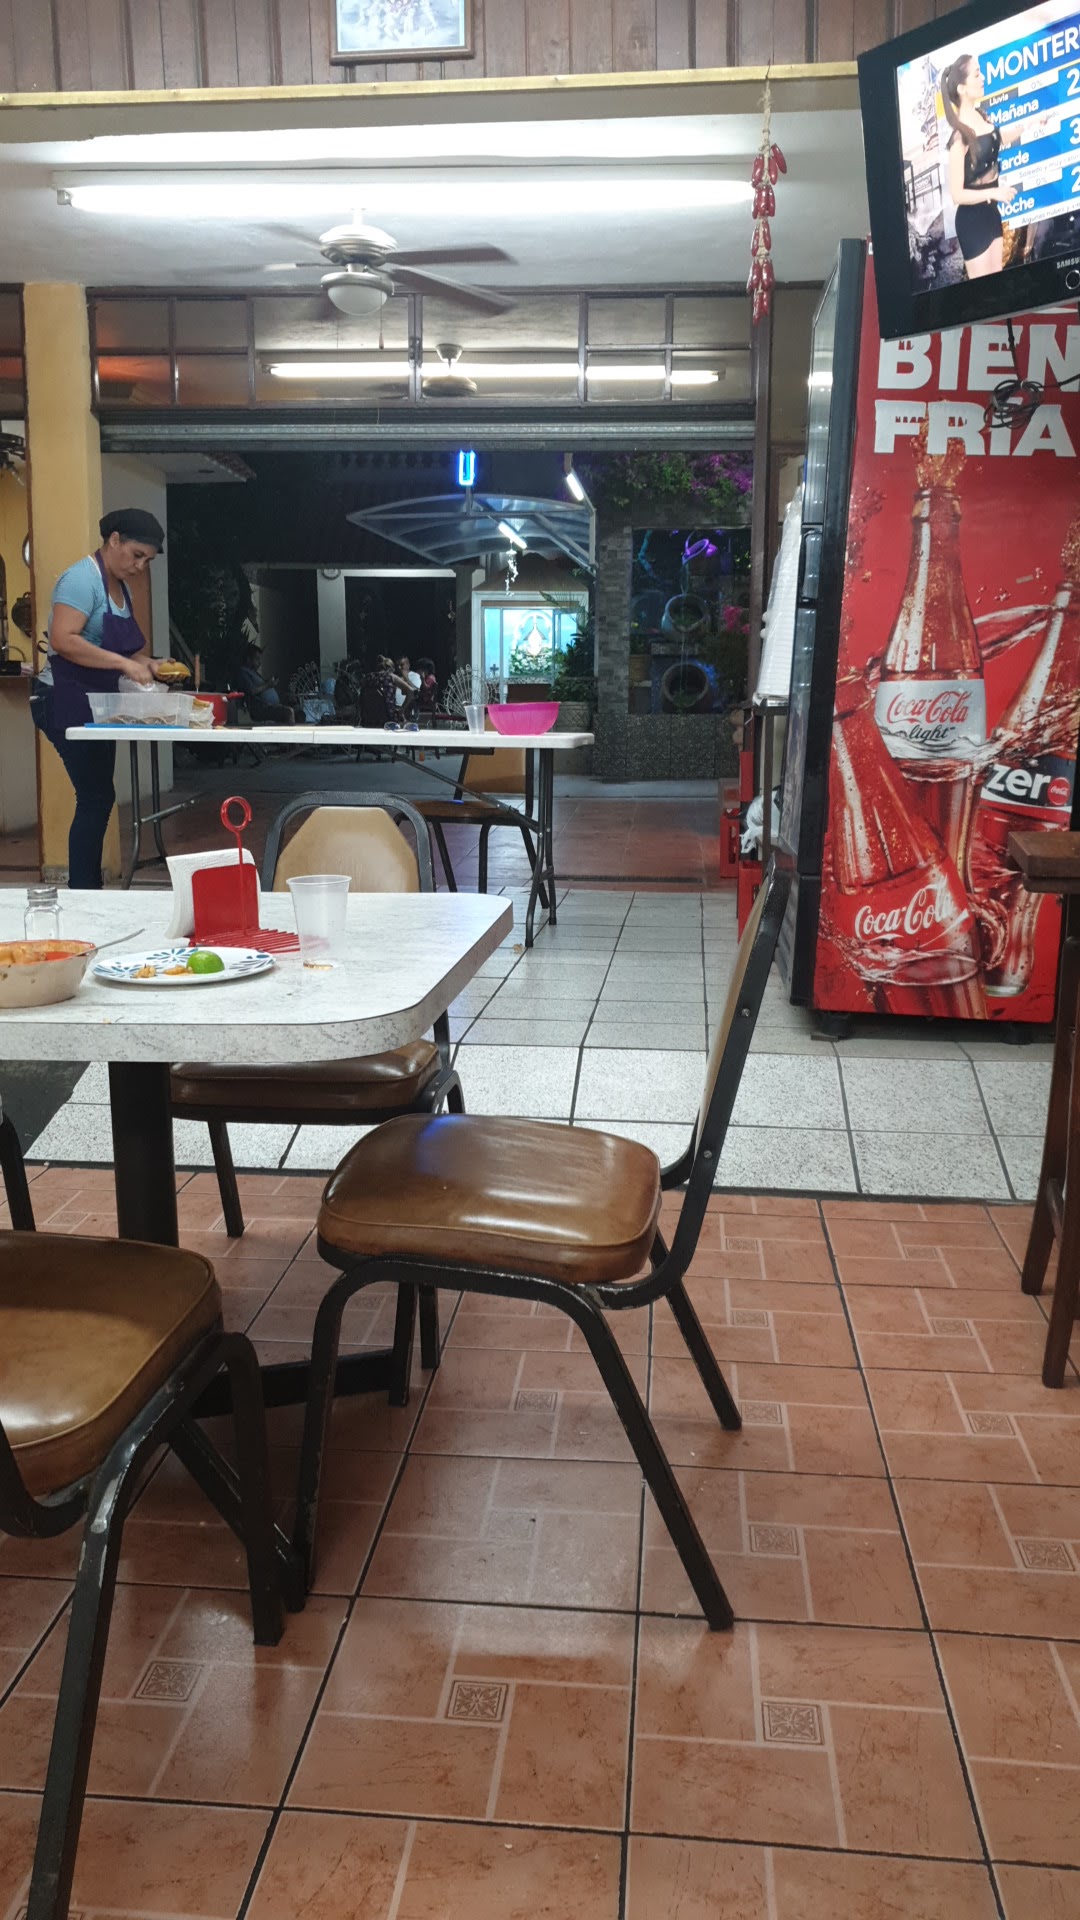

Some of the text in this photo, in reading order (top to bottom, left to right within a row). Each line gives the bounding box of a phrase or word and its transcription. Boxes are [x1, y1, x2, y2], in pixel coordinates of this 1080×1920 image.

[986, 25, 1080, 85] MONTER
[990, 98, 1039, 124] Mañana
[997, 196, 1035, 217] Noche
[1056, 256, 1080, 269] SAMSU
[877, 325, 1080, 392] BIEN
[887, 690, 973, 724] Coca-Cola
[909, 724, 955, 743] light
[855, 872, 969, 945] Coca-Cola
